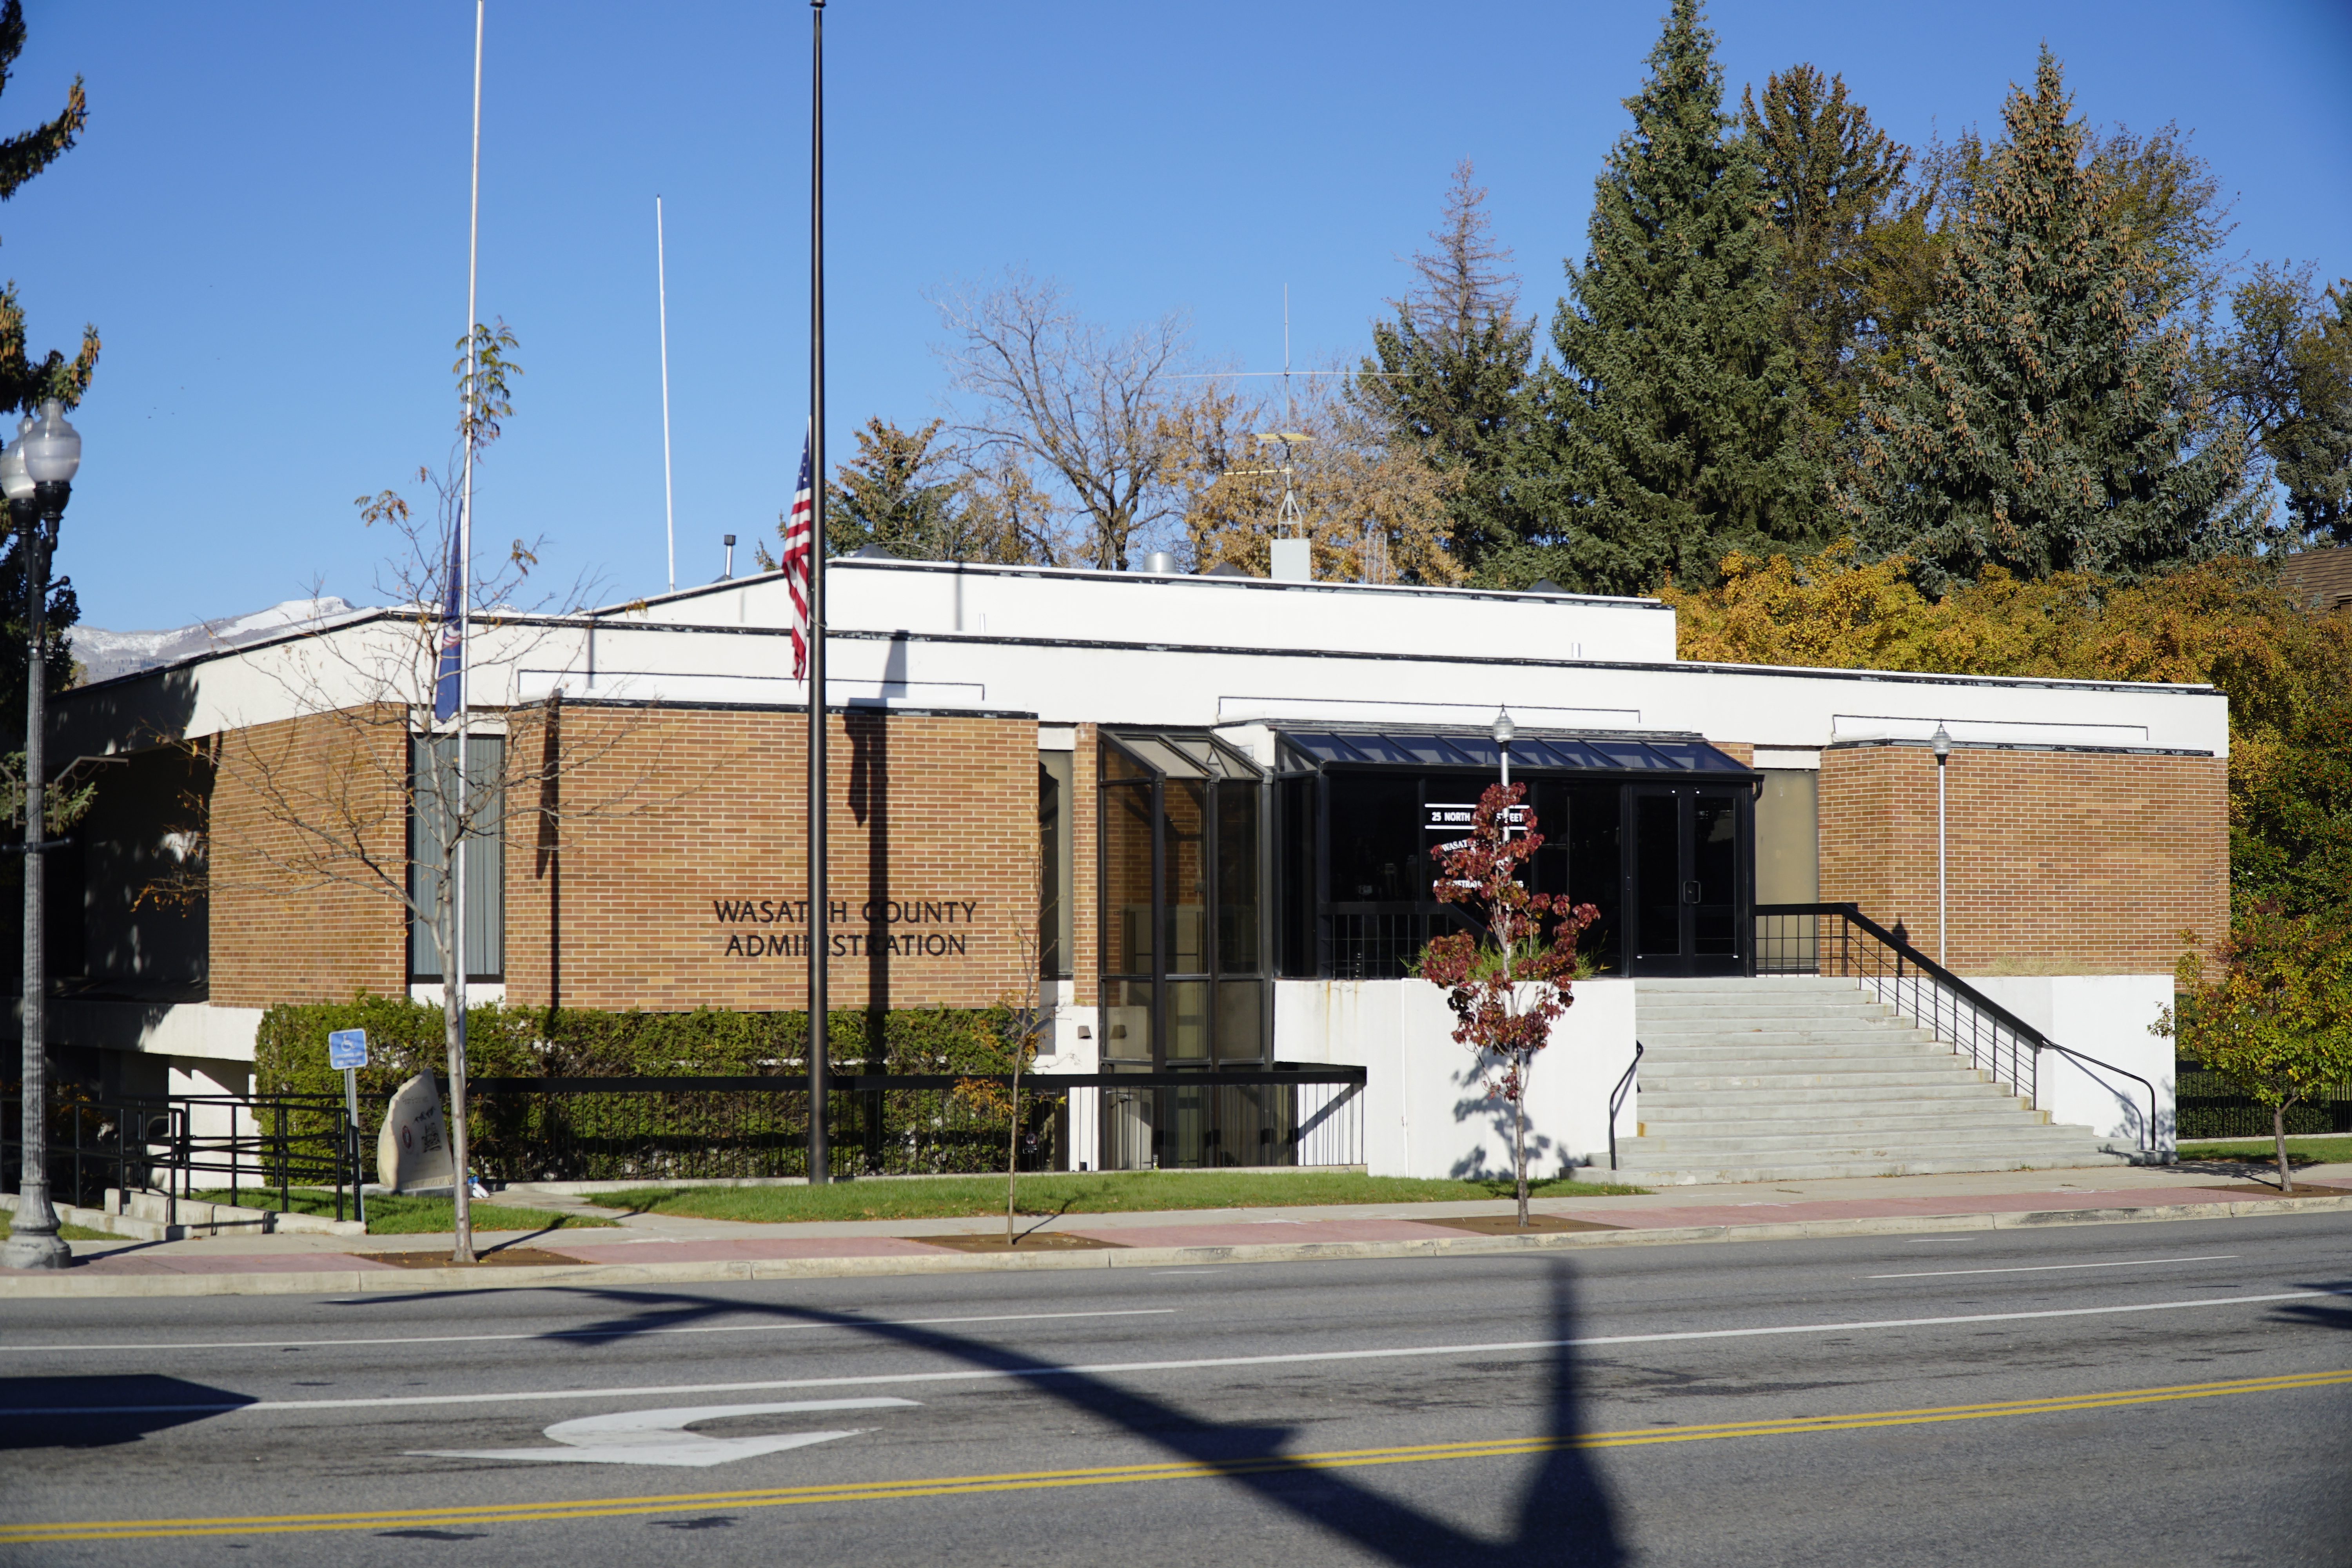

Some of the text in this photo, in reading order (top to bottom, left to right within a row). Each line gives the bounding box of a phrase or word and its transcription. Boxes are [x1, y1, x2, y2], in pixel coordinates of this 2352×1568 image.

[1432, 812, 1523, 822] 25 NORTH SEET
[713, 901, 976, 923] WASATH COUNTY
